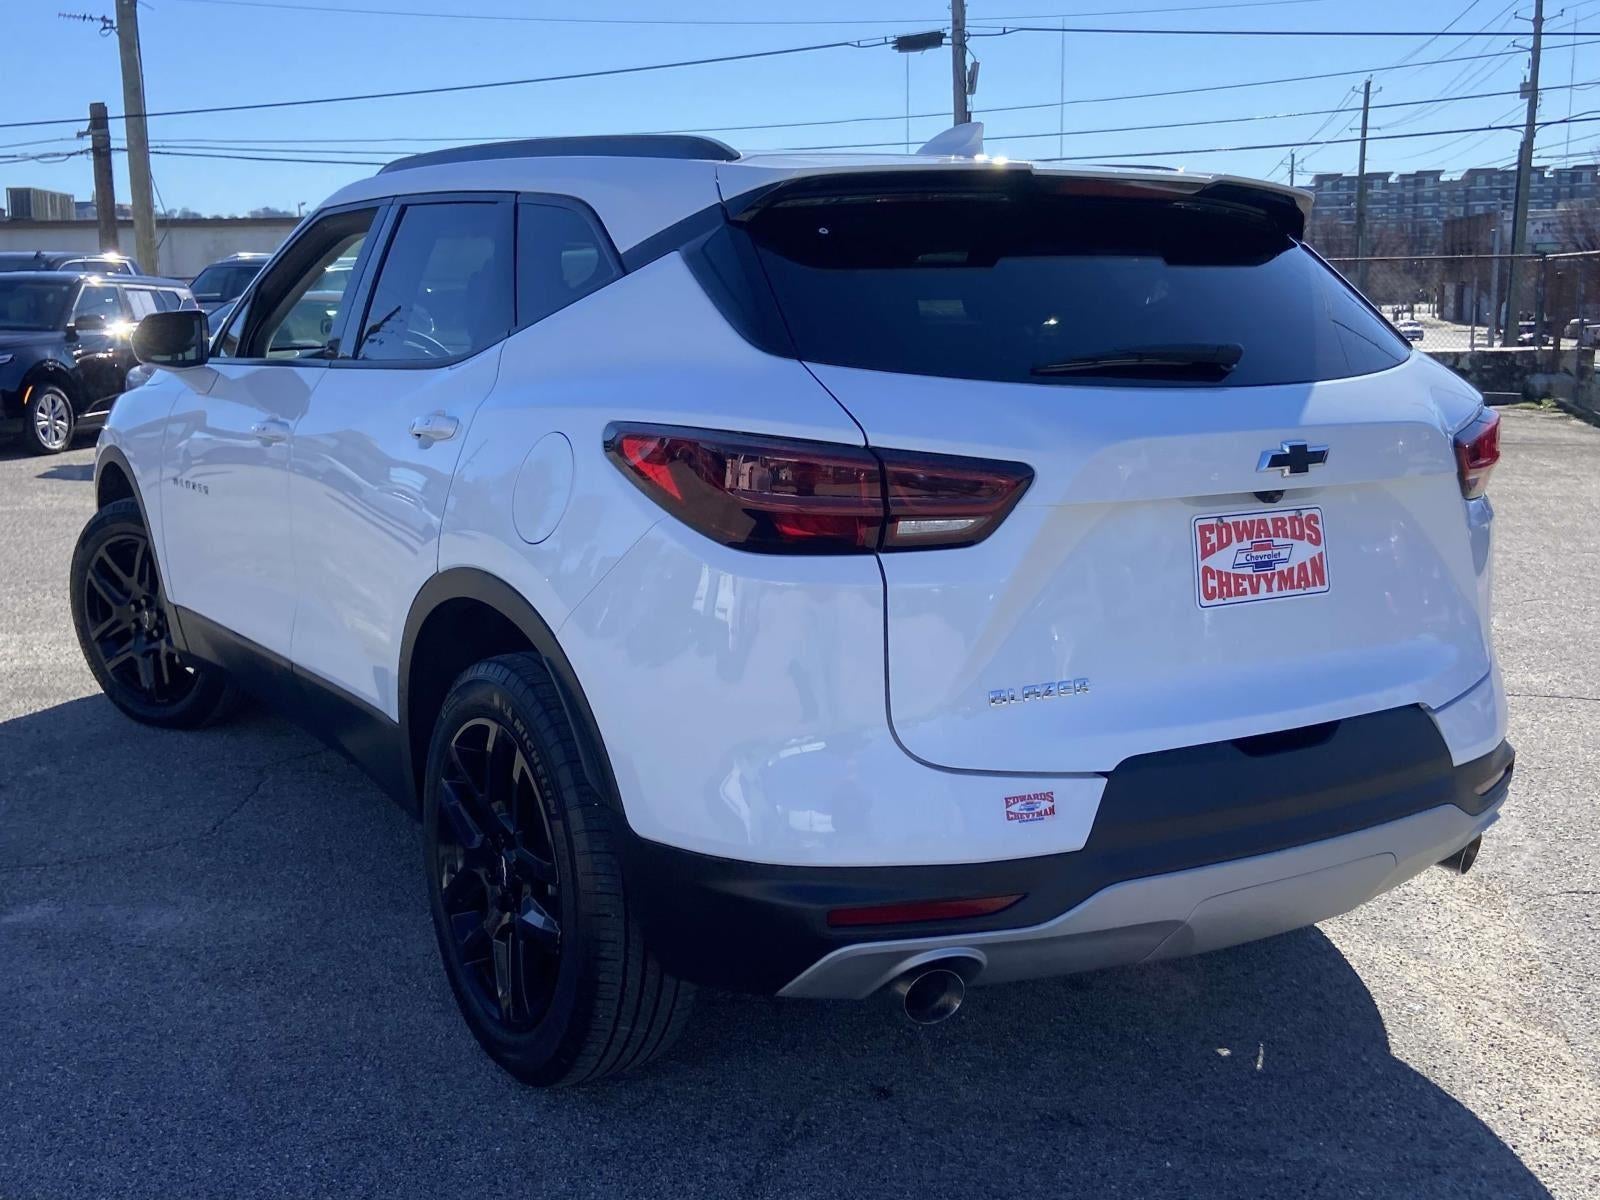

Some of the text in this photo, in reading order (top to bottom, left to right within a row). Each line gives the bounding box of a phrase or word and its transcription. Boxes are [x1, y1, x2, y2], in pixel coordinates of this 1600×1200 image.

[1198, 513, 1322, 561] EDWARDS
[1245, 552, 1281, 562] Chevrolet
[1201, 551, 1326, 601] CHEVYMAN
[989, 678, 1090, 707] BLAZER
[511, 717, 557, 815] MICHELIN
[1004, 791, 1055, 809] EDWARDS
[1006, 804, 1056, 821] CHEVYMAN
